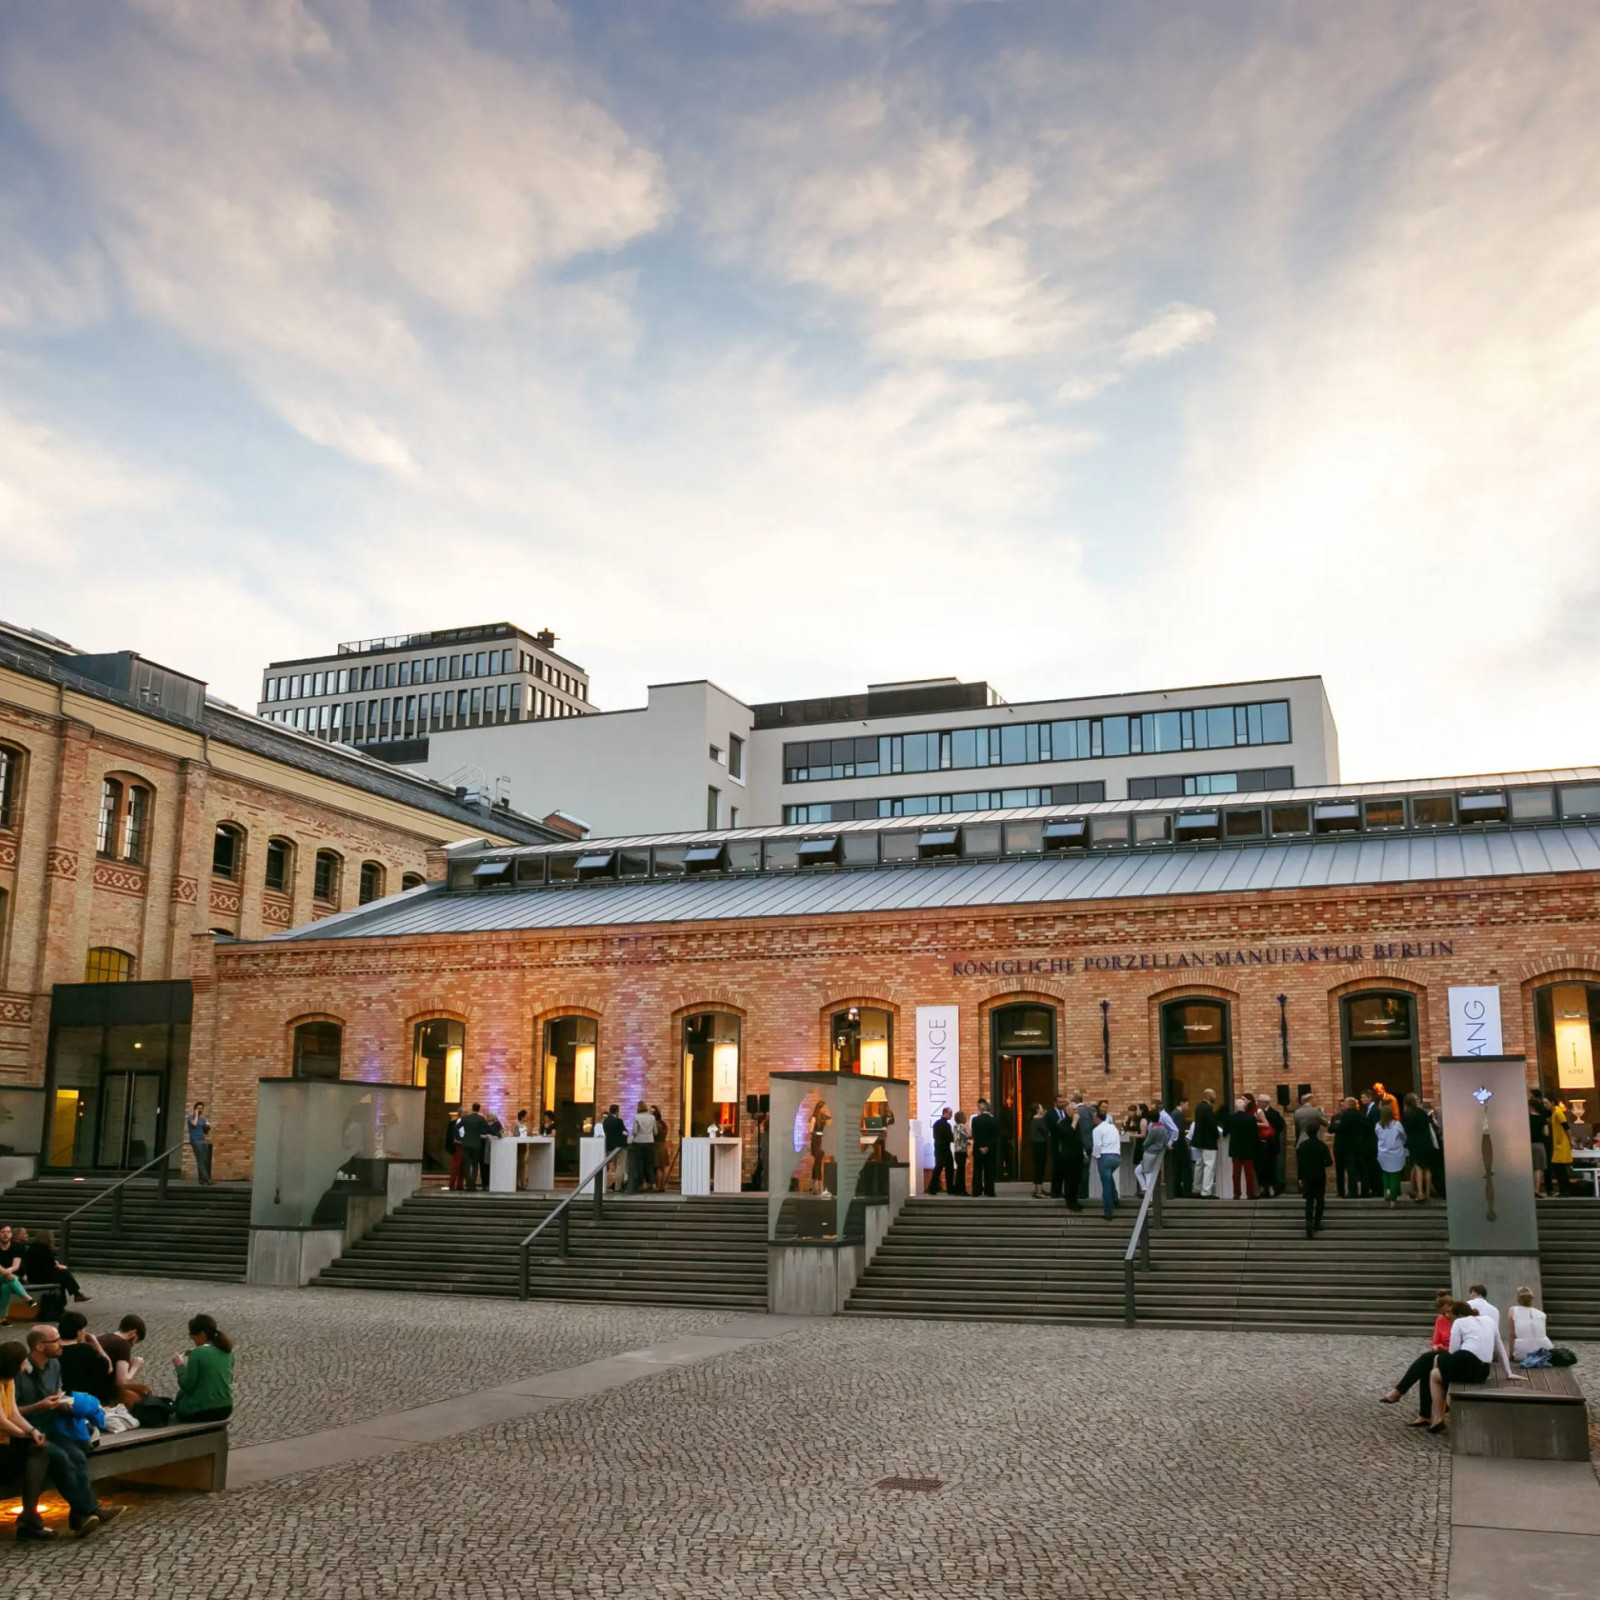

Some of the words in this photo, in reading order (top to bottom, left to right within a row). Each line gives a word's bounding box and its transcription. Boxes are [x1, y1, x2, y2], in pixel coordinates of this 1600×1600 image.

[953, 957, 1075, 976] KÖNIGLICHE
[1083, 944, 1364, 971] PORZELLAN-MANUFAKTUR
[1374, 940, 1454, 960] BERLIN
